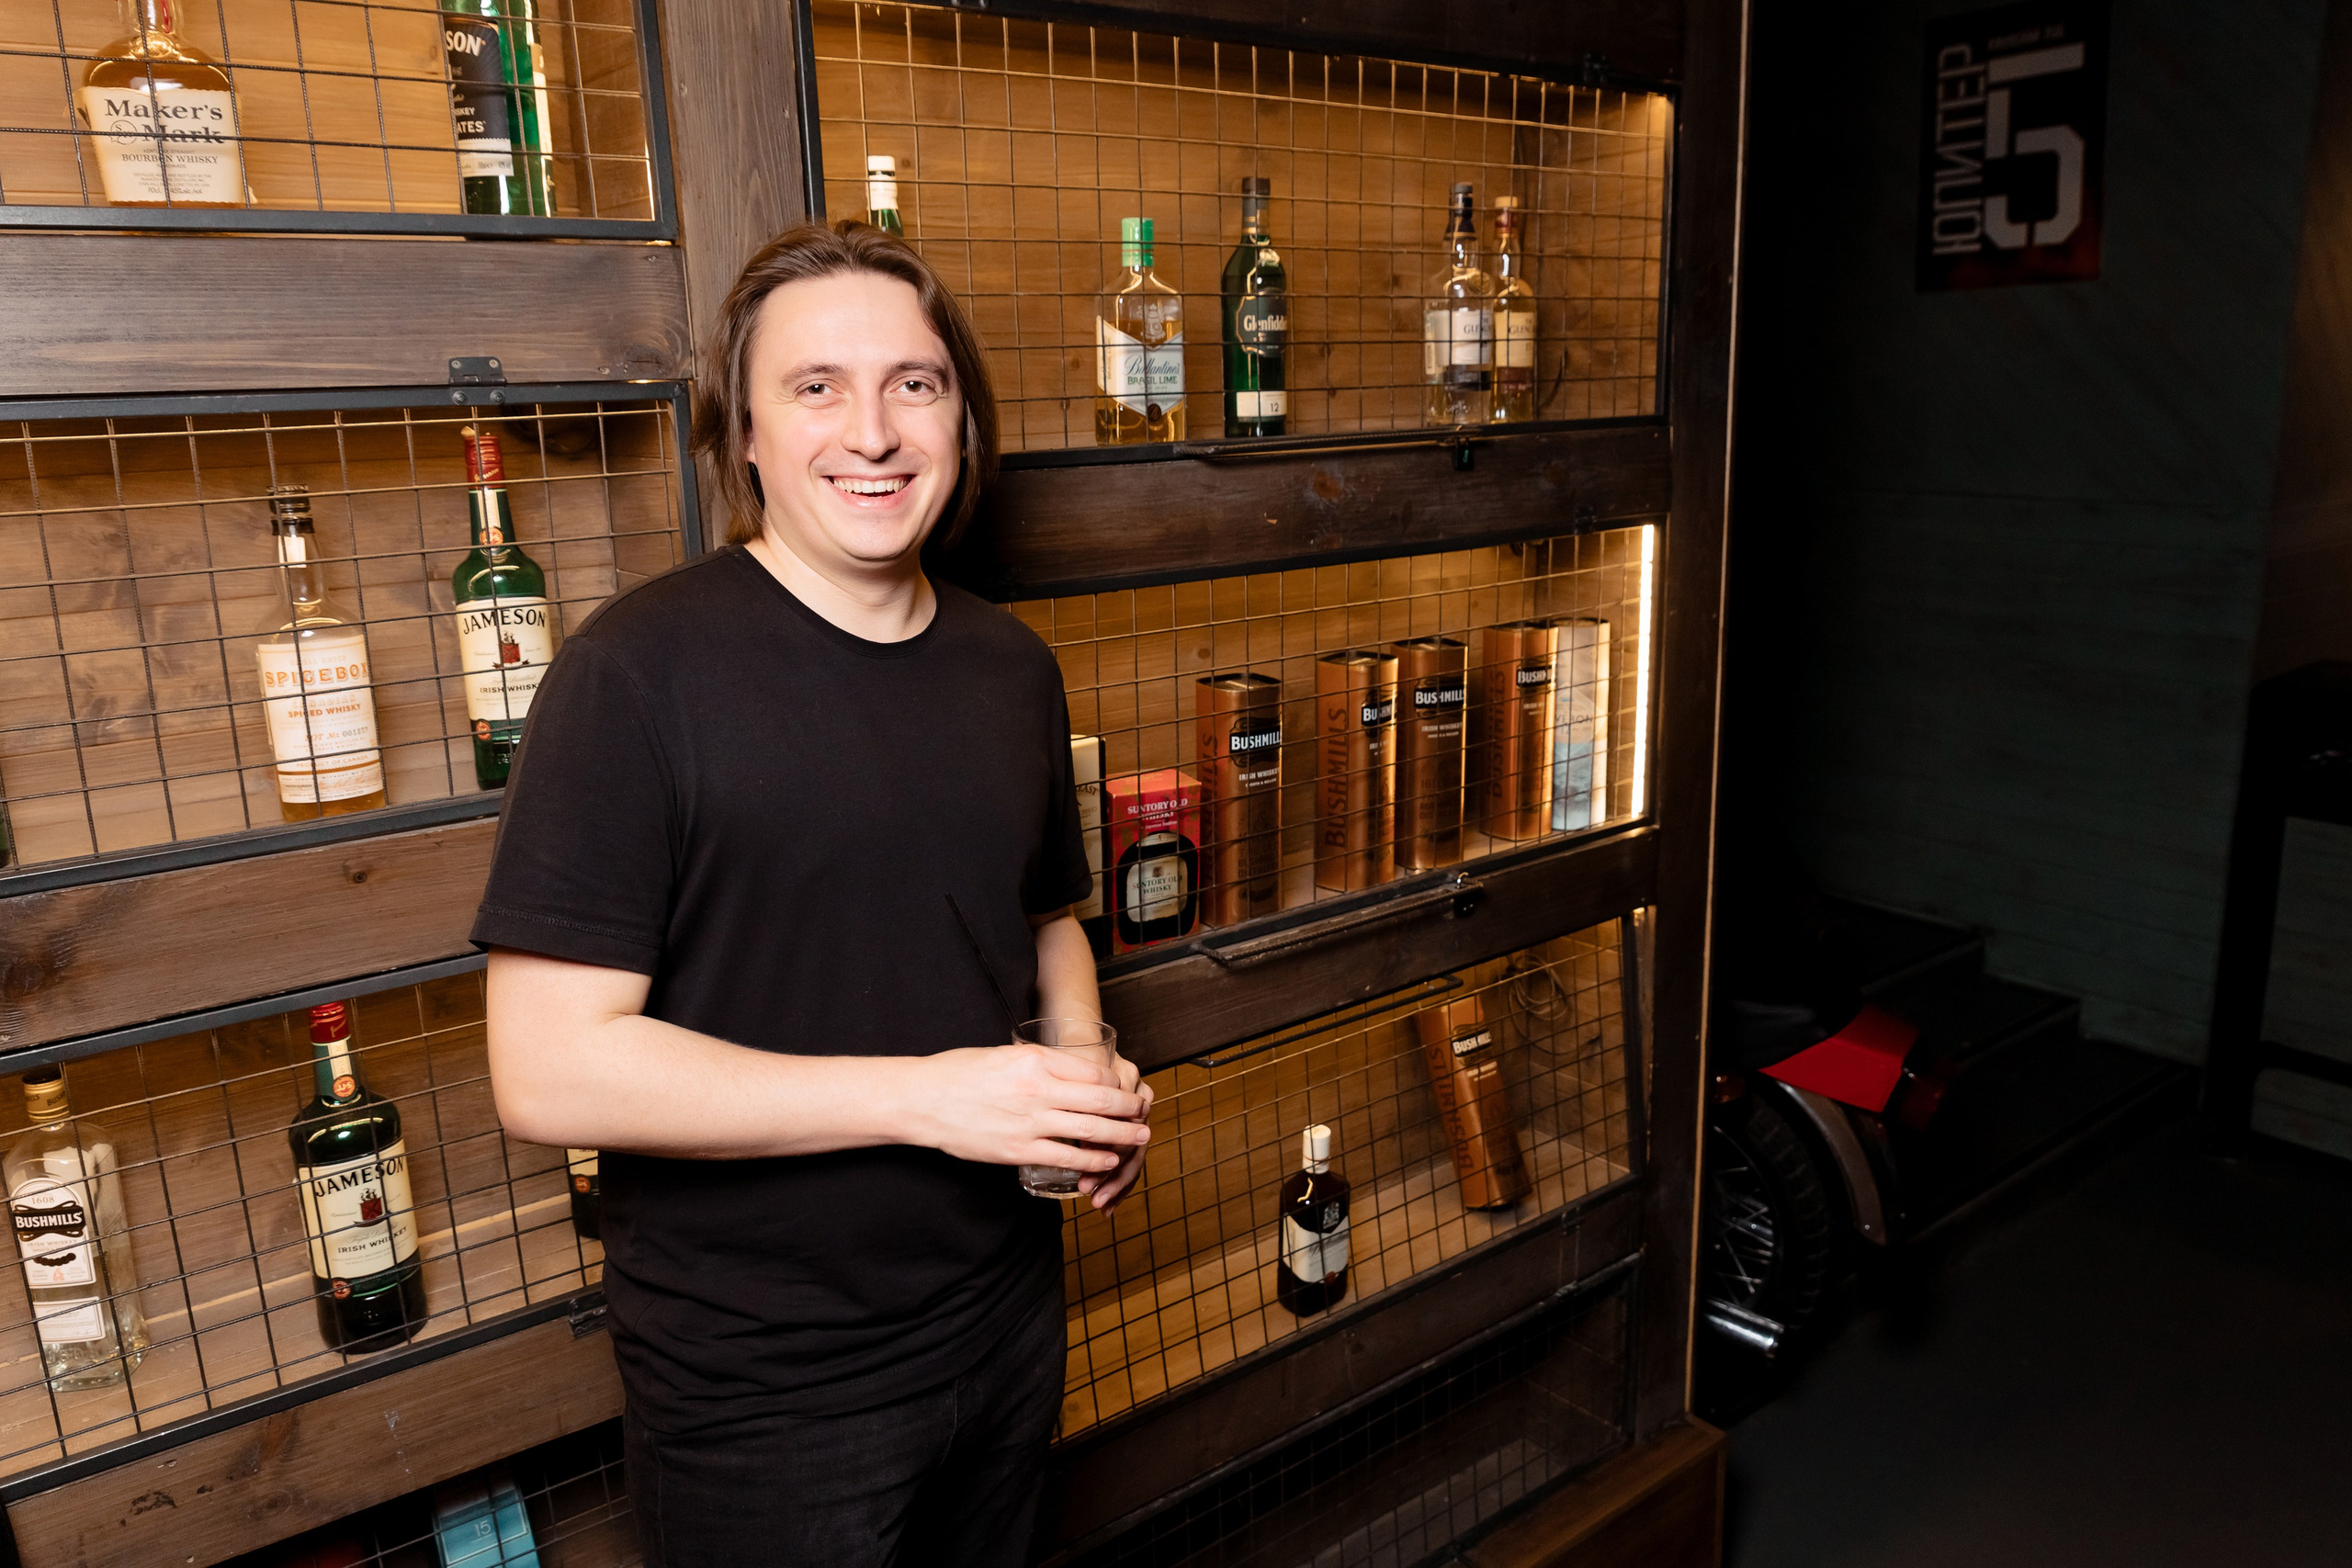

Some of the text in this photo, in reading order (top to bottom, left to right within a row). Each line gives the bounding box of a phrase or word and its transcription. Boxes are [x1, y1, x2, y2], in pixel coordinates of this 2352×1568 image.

[104, 98, 223, 120] Maker's
[141, 124, 225, 144] Mark
[1931, 41, 1986, 255] ЮПИТЕР
[1984, 40, 2086, 251] 5
[122, 153, 218, 164] BOURBN WHISKY
[1127, 375, 1178, 386] BRASIL LIME
[1270, 402, 1279, 412] 12
[463, 608, 547, 635] JAMESON
[325, 703, 361, 715] WHISKY
[1127, 800, 1169, 815] SUNTORY
[1132, 877, 1168, 890] SUNTORY
[1143, 884, 1172, 895] WHISKY
[315, 1156, 404, 1198] JAMESON
[31, 1196, 55, 1205] 1608
[15, 1212, 83, 1229] BUSHMILLS
[337, 1243, 367, 1254] IRISH
[474, 1519, 492, 1538] 15
